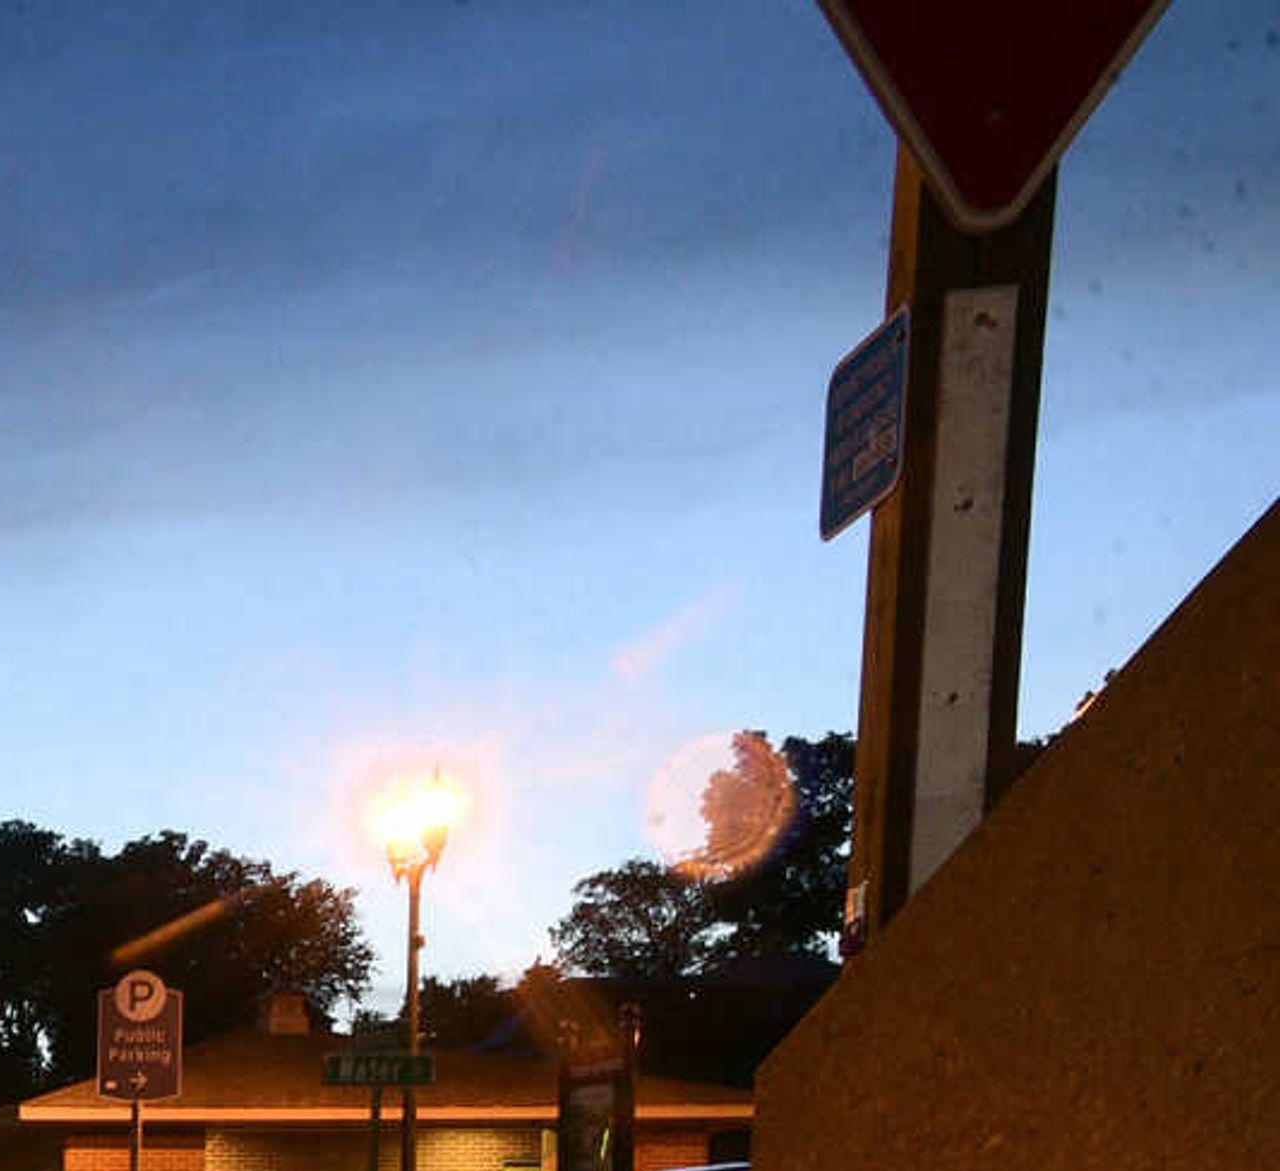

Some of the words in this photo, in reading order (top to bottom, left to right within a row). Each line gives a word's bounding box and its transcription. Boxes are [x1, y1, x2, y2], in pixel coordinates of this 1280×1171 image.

[129, 980, 154, 1012] P
[113, 1026, 167, 1043] Public
[108, 1047, 172, 1066] Parking
